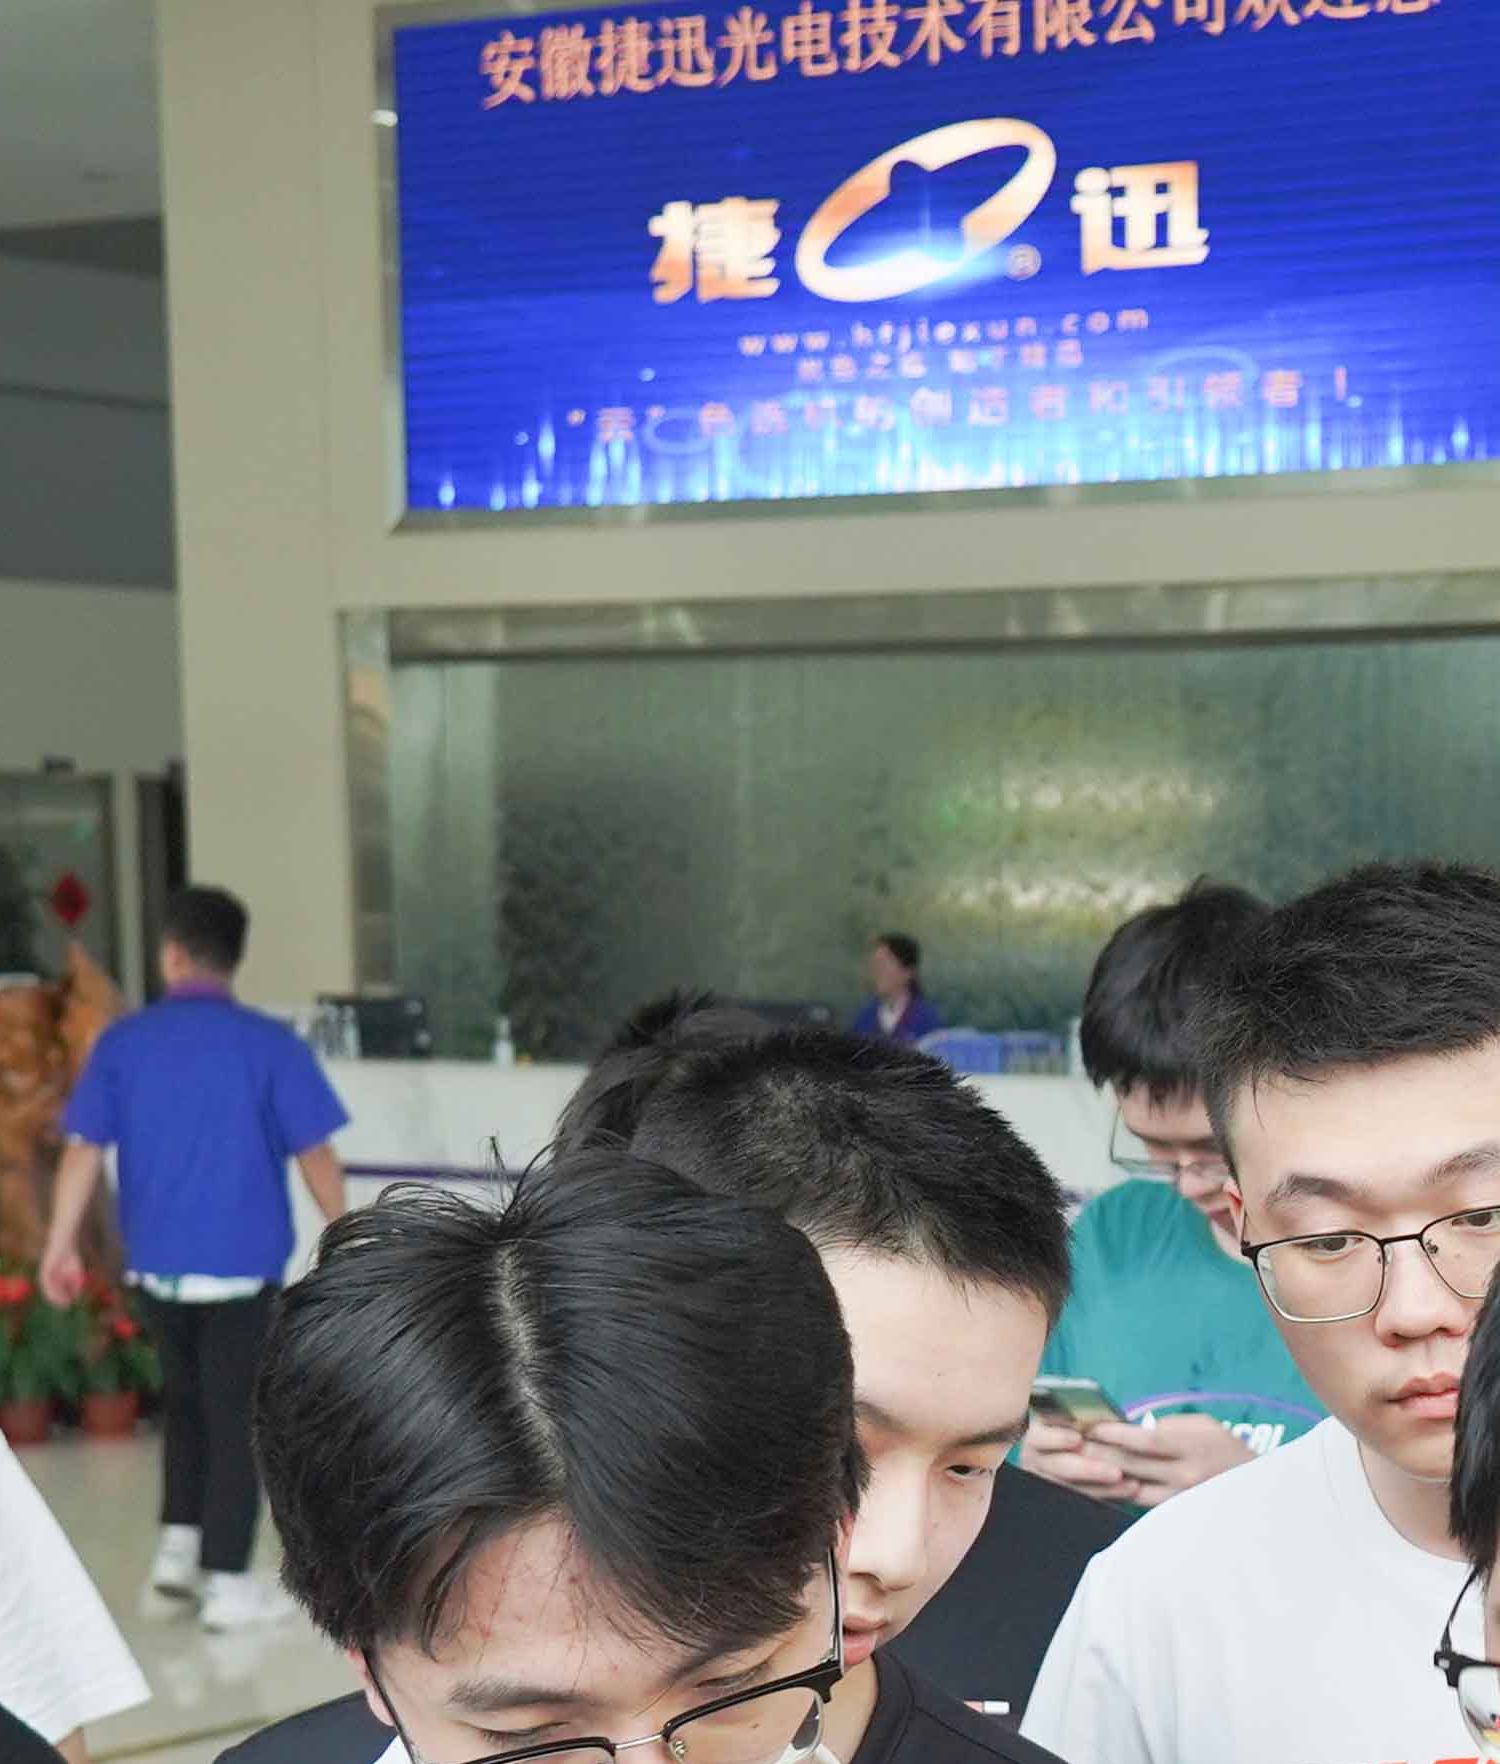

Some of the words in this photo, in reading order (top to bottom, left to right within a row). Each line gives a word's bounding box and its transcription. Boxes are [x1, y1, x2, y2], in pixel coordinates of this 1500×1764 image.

[480, 0, 1442, 109] 安徽捷迅光电技术有限公司
[648, 196, 782, 304] 捷
[1069, 160, 1211, 274] 迅
